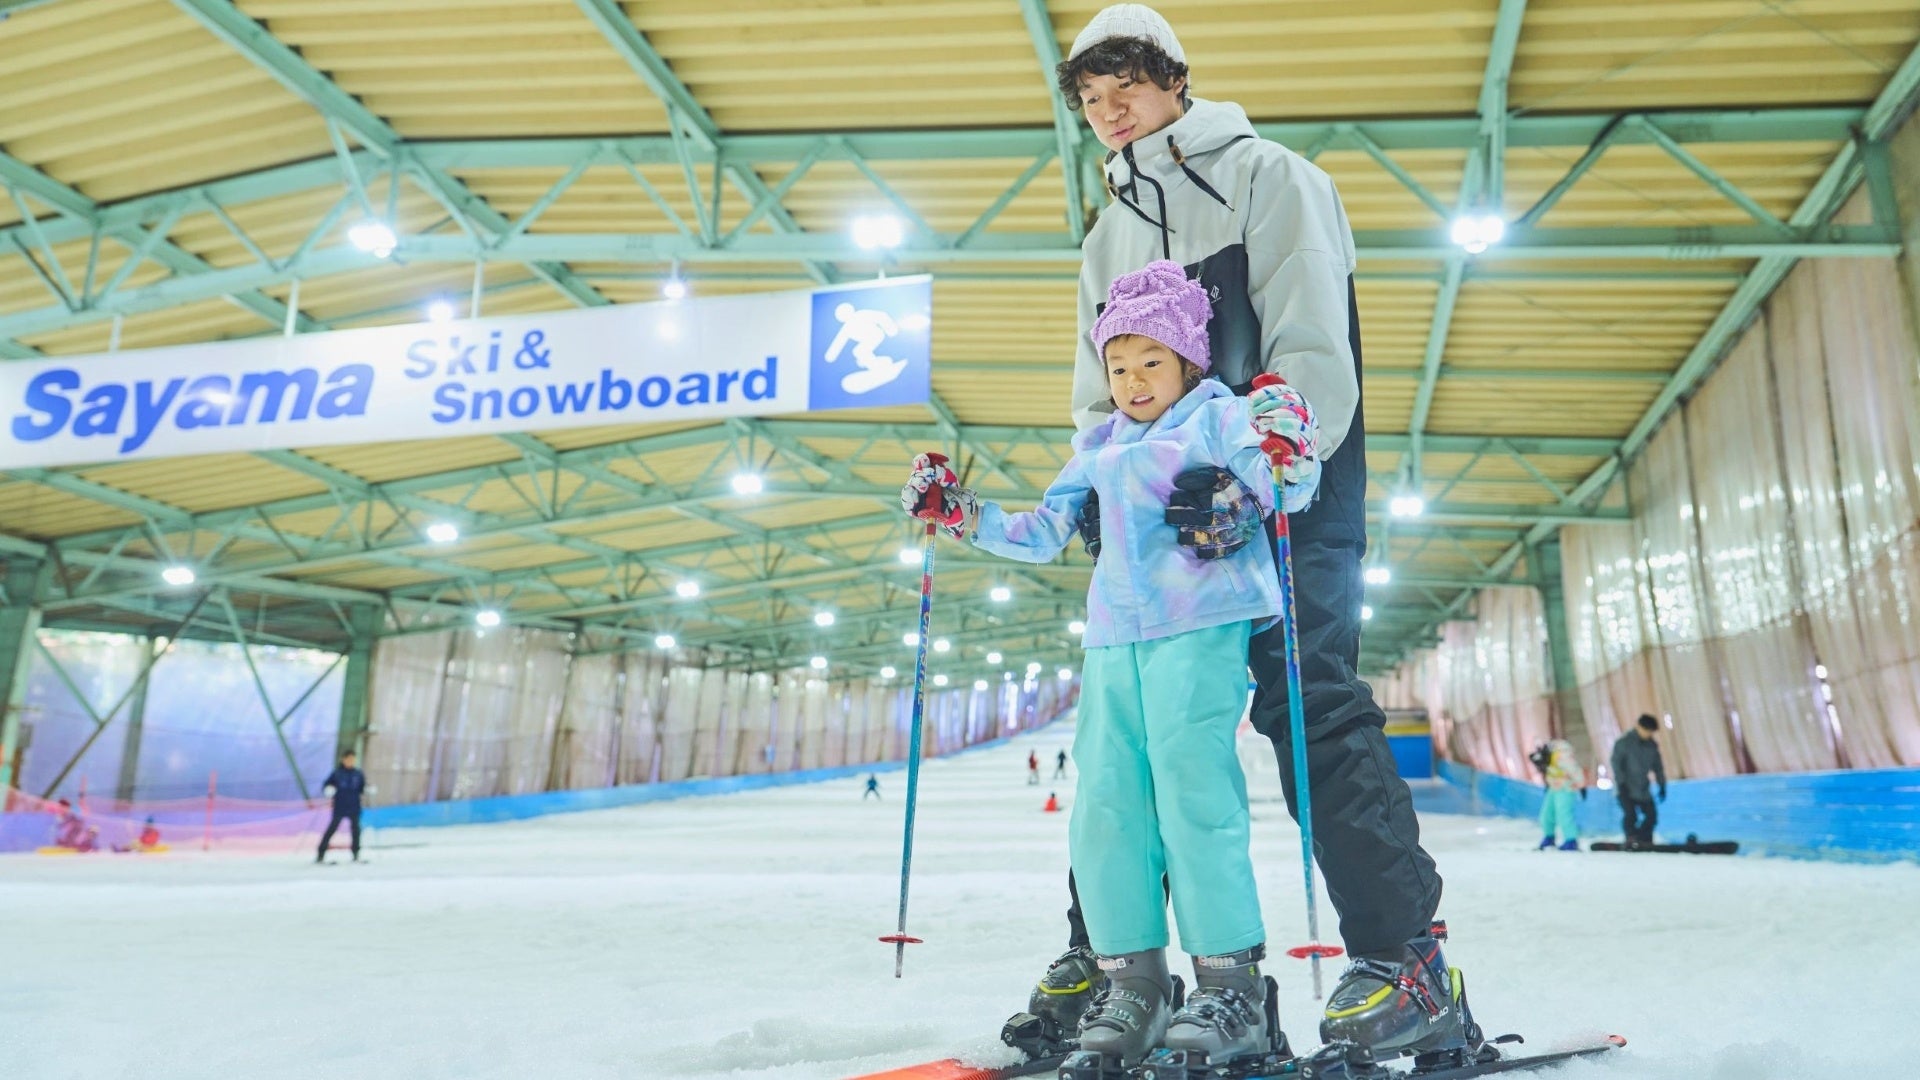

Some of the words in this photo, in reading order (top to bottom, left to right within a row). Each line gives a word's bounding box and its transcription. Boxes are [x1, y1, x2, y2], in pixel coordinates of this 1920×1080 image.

[403, 330, 503, 379] Ski
[514, 329, 551, 370] &
[12, 363, 374, 454] Sayama
[431, 356, 779, 423] Snowboard
